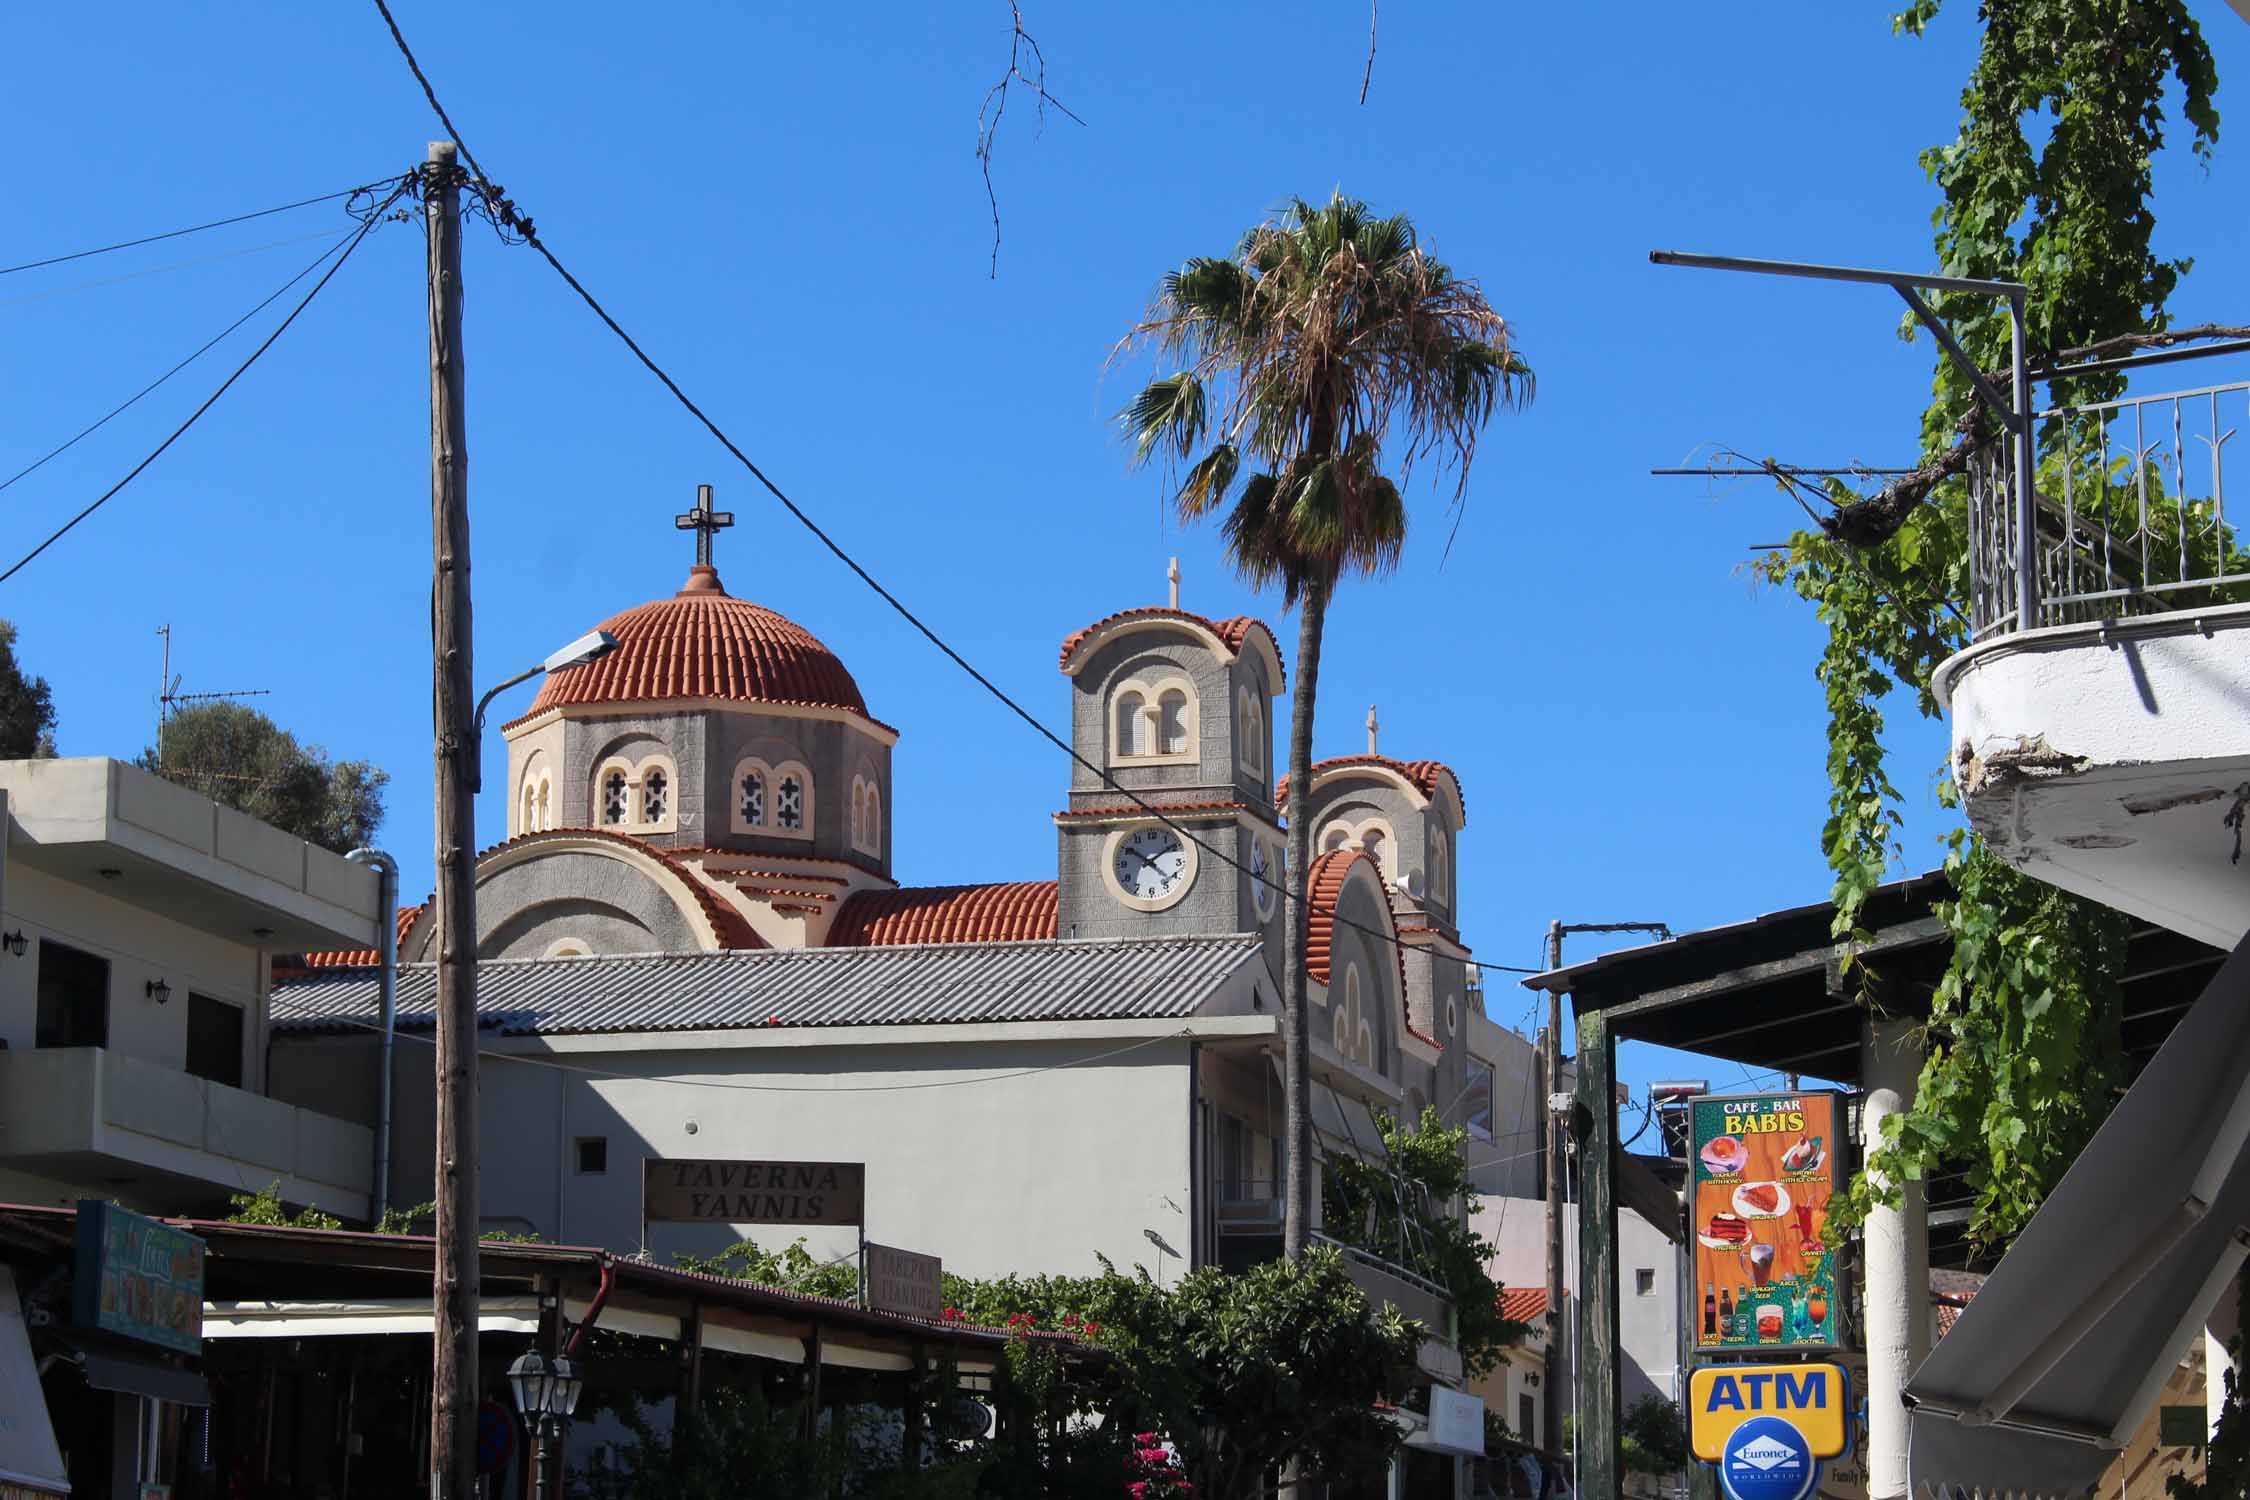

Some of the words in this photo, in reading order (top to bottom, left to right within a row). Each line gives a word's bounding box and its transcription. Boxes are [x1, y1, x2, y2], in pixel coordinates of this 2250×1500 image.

[1723, 1102, 1759, 1114] CAFE
[1773, 1100, 1801, 1112] BAR
[1725, 1112, 1805, 1135] BABIS
[673, 1162, 838, 1191] TAVERNA
[690, 1193, 825, 1219] YANNIS
[1706, 1371, 1827, 1413] ATM
[1743, 1447, 1788, 1459] Euronet
